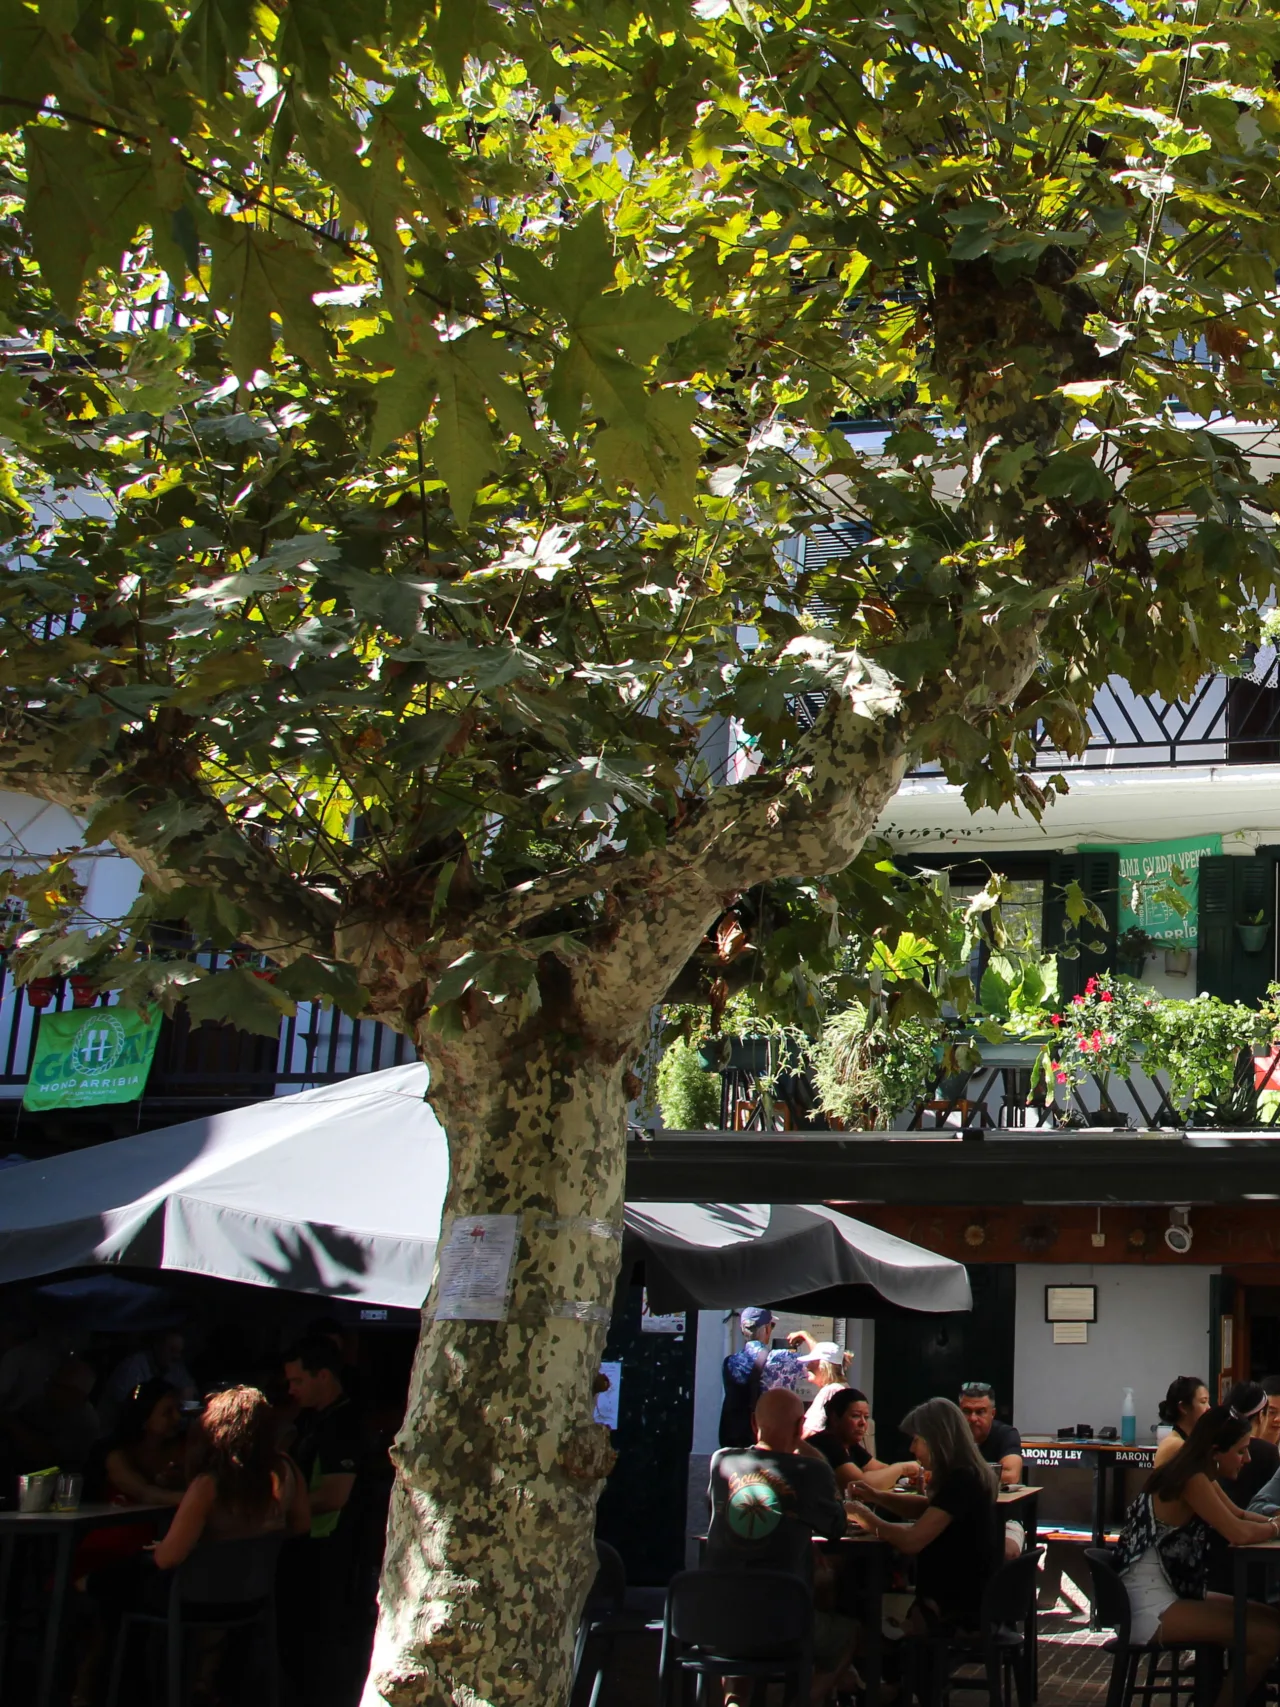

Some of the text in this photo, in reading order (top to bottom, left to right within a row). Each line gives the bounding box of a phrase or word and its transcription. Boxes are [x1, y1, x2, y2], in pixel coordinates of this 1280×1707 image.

[1021, 1448, 1083, 1460] ARON DE LEY
[1115, 1451, 1150, 1461] BARON
[1138, 1461, 1156, 1469] RIO
